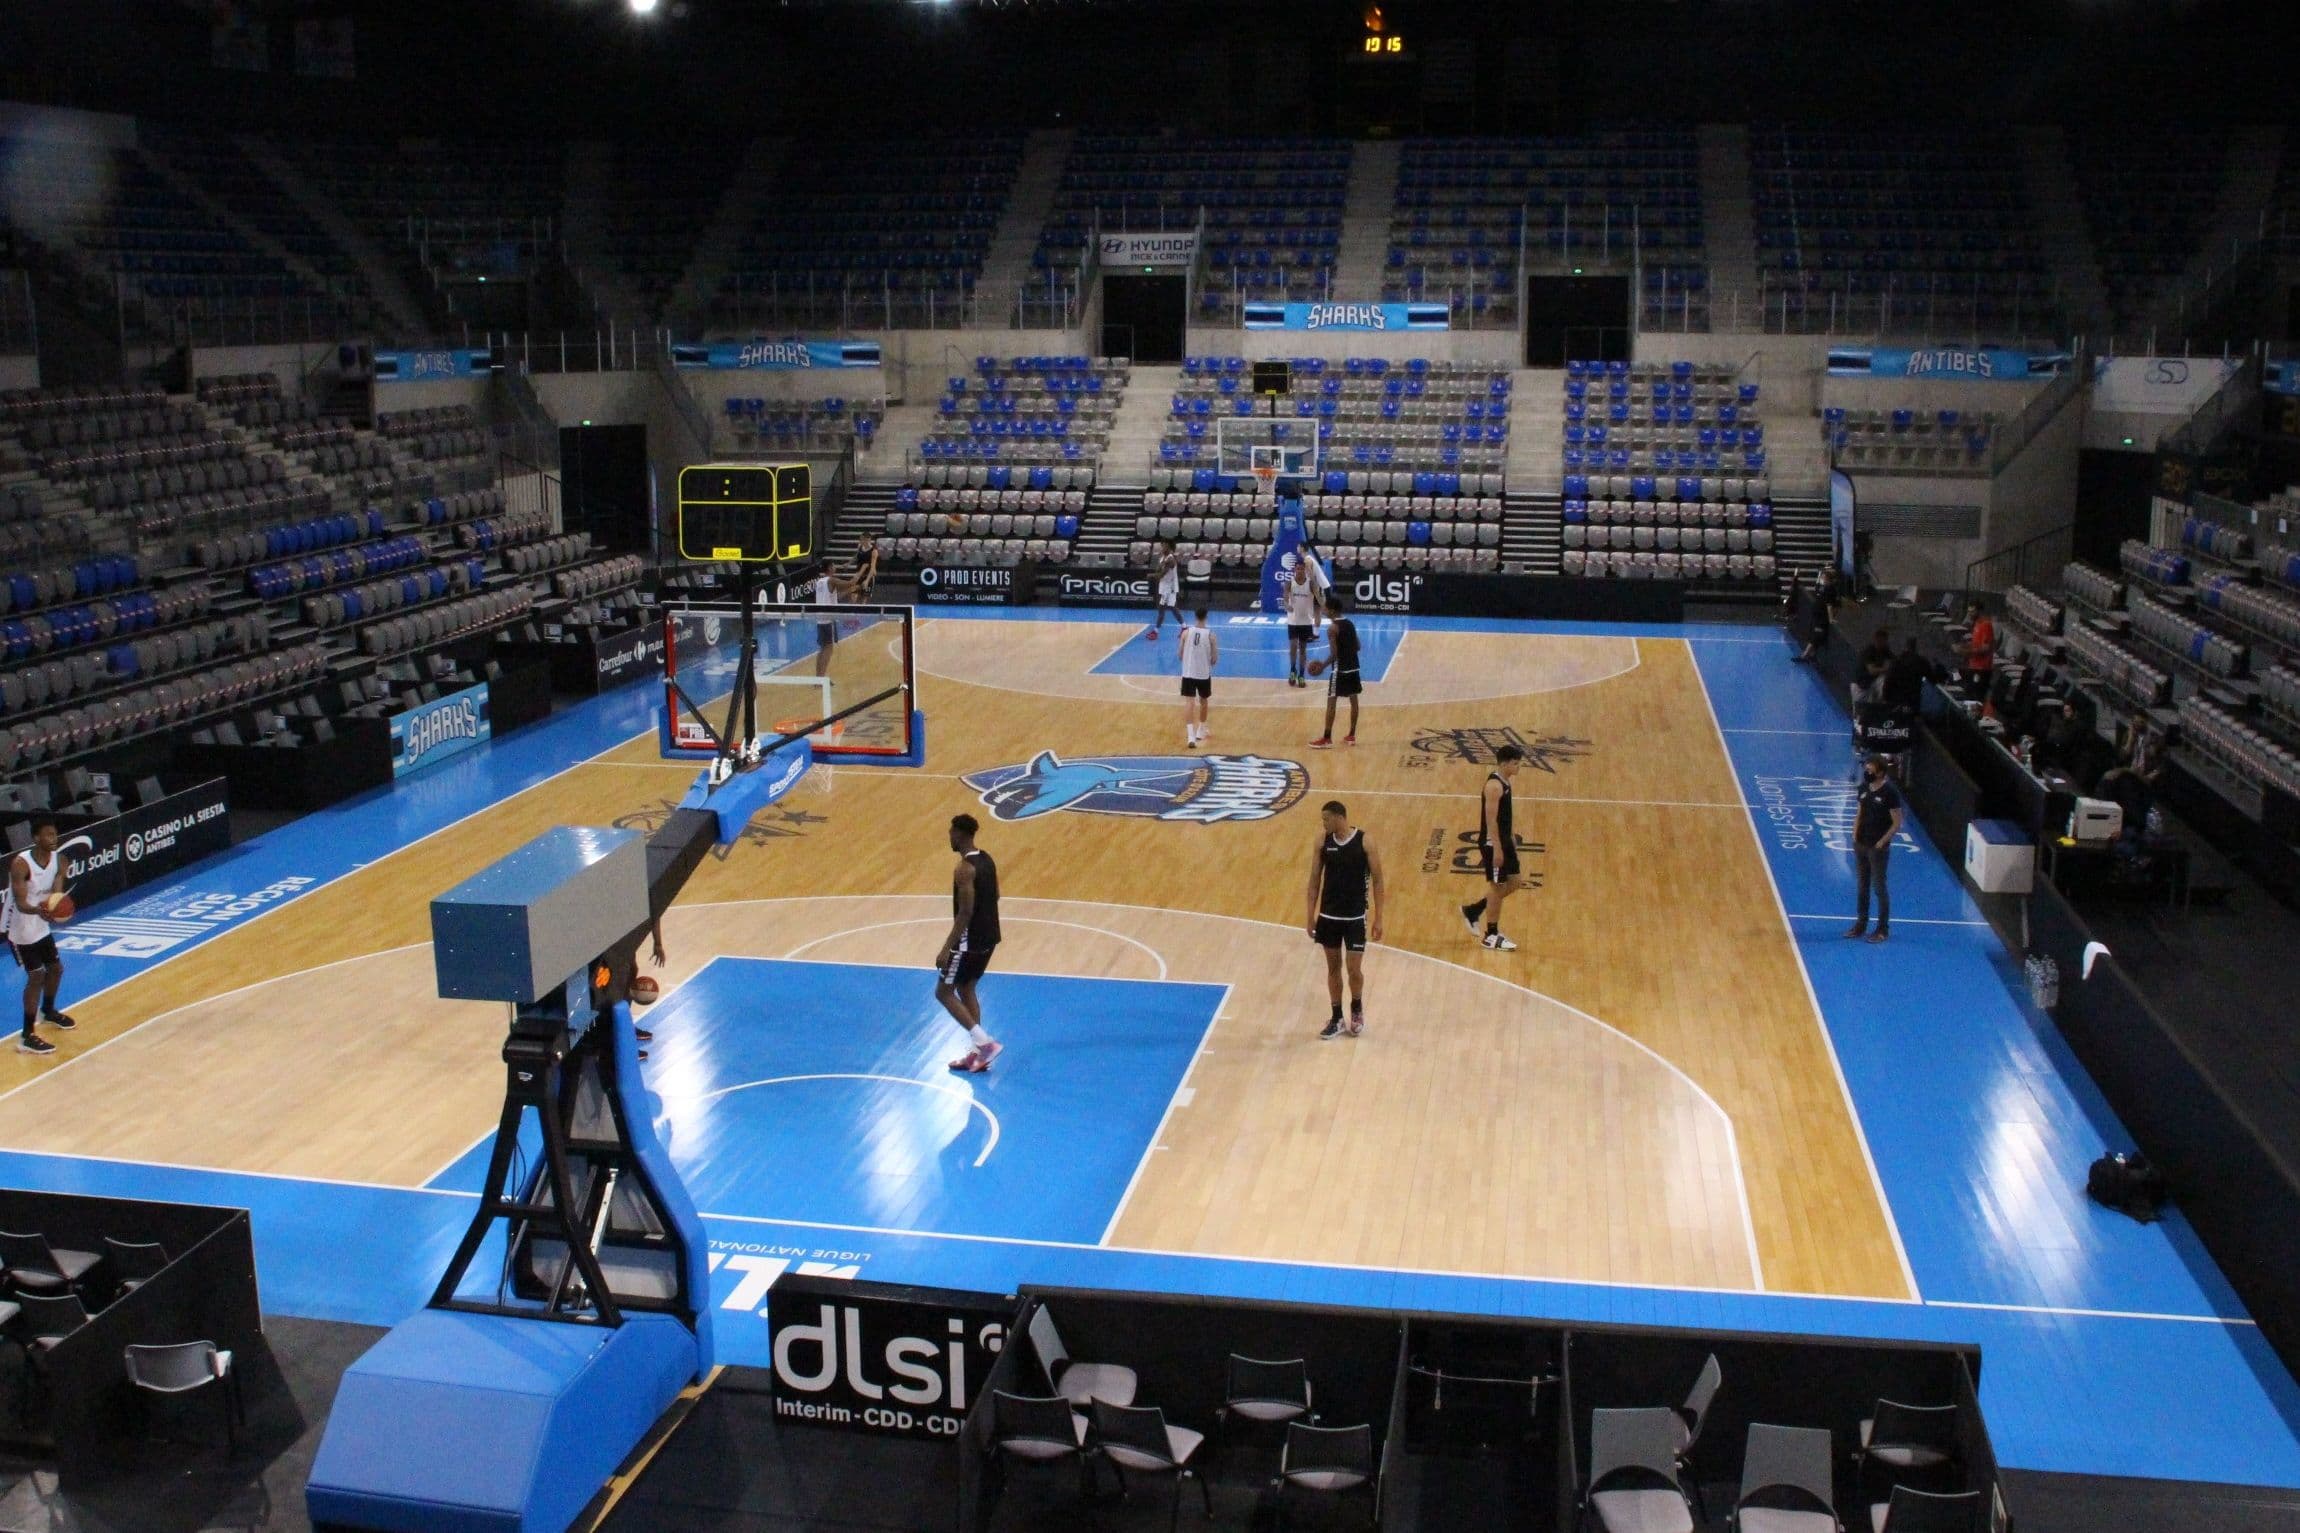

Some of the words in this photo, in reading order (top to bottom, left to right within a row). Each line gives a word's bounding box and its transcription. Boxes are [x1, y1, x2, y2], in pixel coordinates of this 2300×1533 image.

[1130, 239, 1194, 251] HYUNDA
[1307, 304, 1386, 330] SHARKS
[739, 343, 811, 368] SHARKS
[1906, 350, 1993, 377] ANTIBES
[944, 570, 969, 584] PROD
[972, 570, 1010, 586] EVENTS
[1274, 571, 1297, 582] GS
[1355, 574, 1410, 602] dlsi
[407, 697, 477, 765] SHARKS
[1867, 727, 1909, 738] SPALDING
[1160, 754, 1302, 824] SHARKS
[144, 819, 182, 843] CASINO
[183, 814, 195, 828] LA
[197, 802, 226, 823] SIESTA
[146, 835, 176, 855] ANTIBES
[66, 859, 85, 878] du
[88, 843, 120, 871] soleil
[169, 893, 237, 918] SUD
[708, 1239, 806, 1257] NATIONAL
[811, 1249, 872, 1262] LIGUE
[774, 1304, 965, 1410] dlsi
